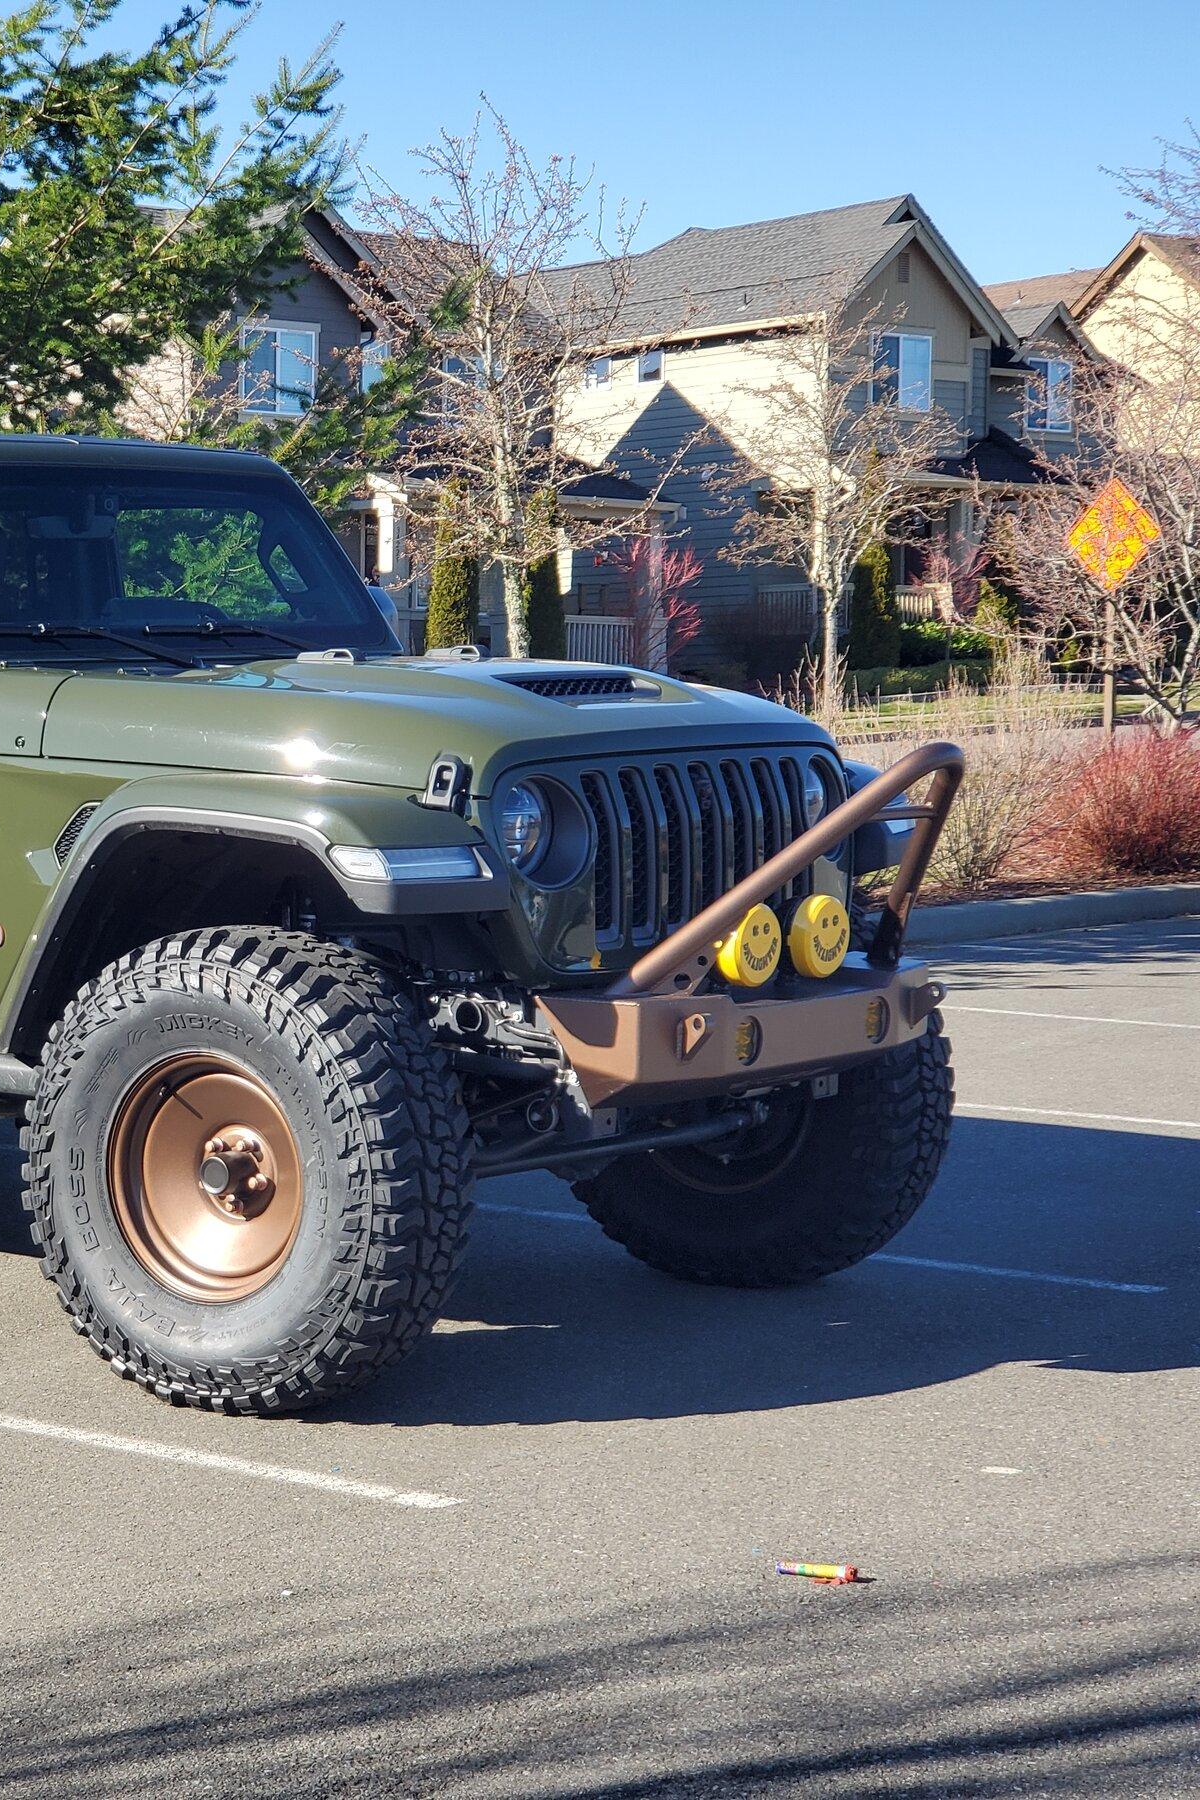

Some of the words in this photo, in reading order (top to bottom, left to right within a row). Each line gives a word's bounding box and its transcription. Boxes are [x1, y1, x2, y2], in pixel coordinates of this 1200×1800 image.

[743, 936, 778, 971] DAYLIGHTER
[813, 928, 847, 963] DAYLIGHTER
[154, 1012, 254, 1047] MICKEY
[67, 1146, 100, 1252] BOSS
[102, 1265, 176, 1337] BAJA
